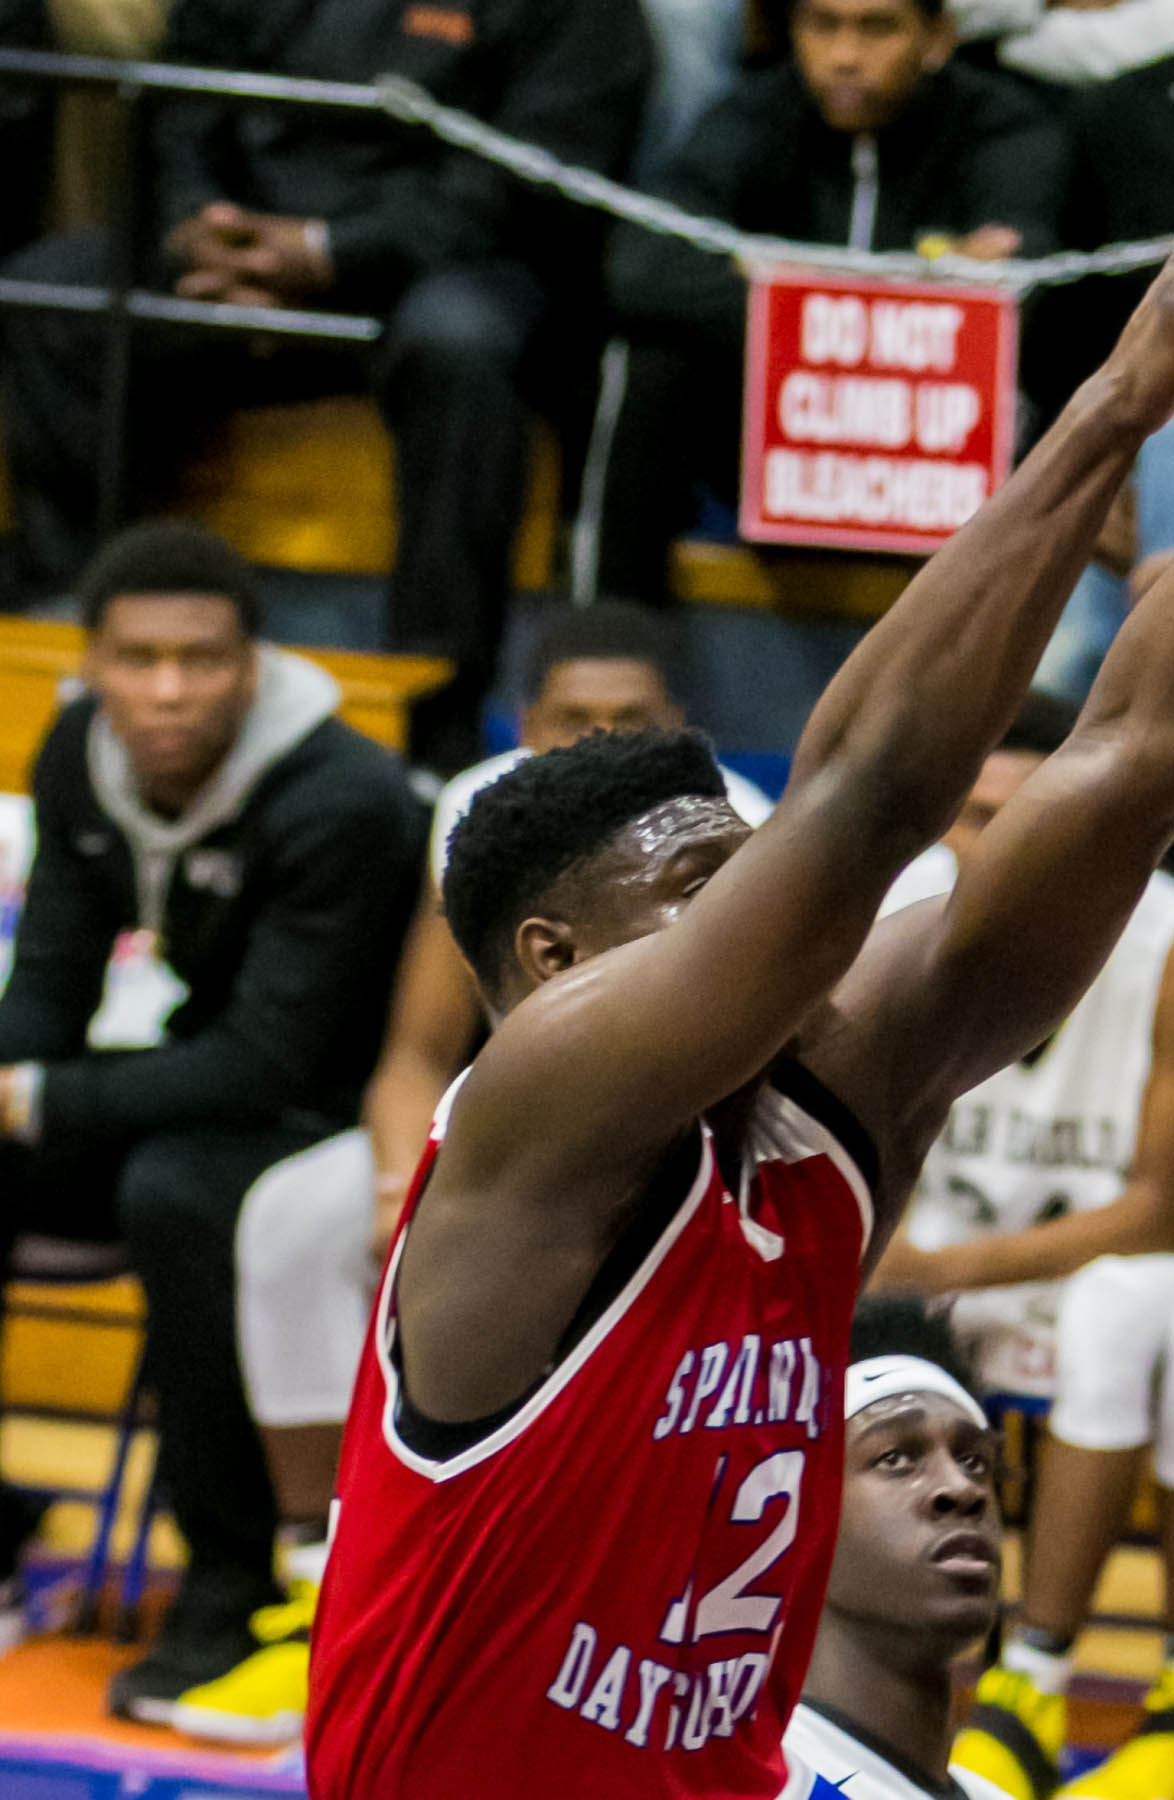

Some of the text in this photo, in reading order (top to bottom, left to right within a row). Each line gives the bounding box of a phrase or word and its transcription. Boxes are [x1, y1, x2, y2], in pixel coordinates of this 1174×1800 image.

[801, 292, 966, 372] DO NOT
[778, 369, 981, 453] CLIMB UP
[763, 446, 988, 528] BLEACHERS
